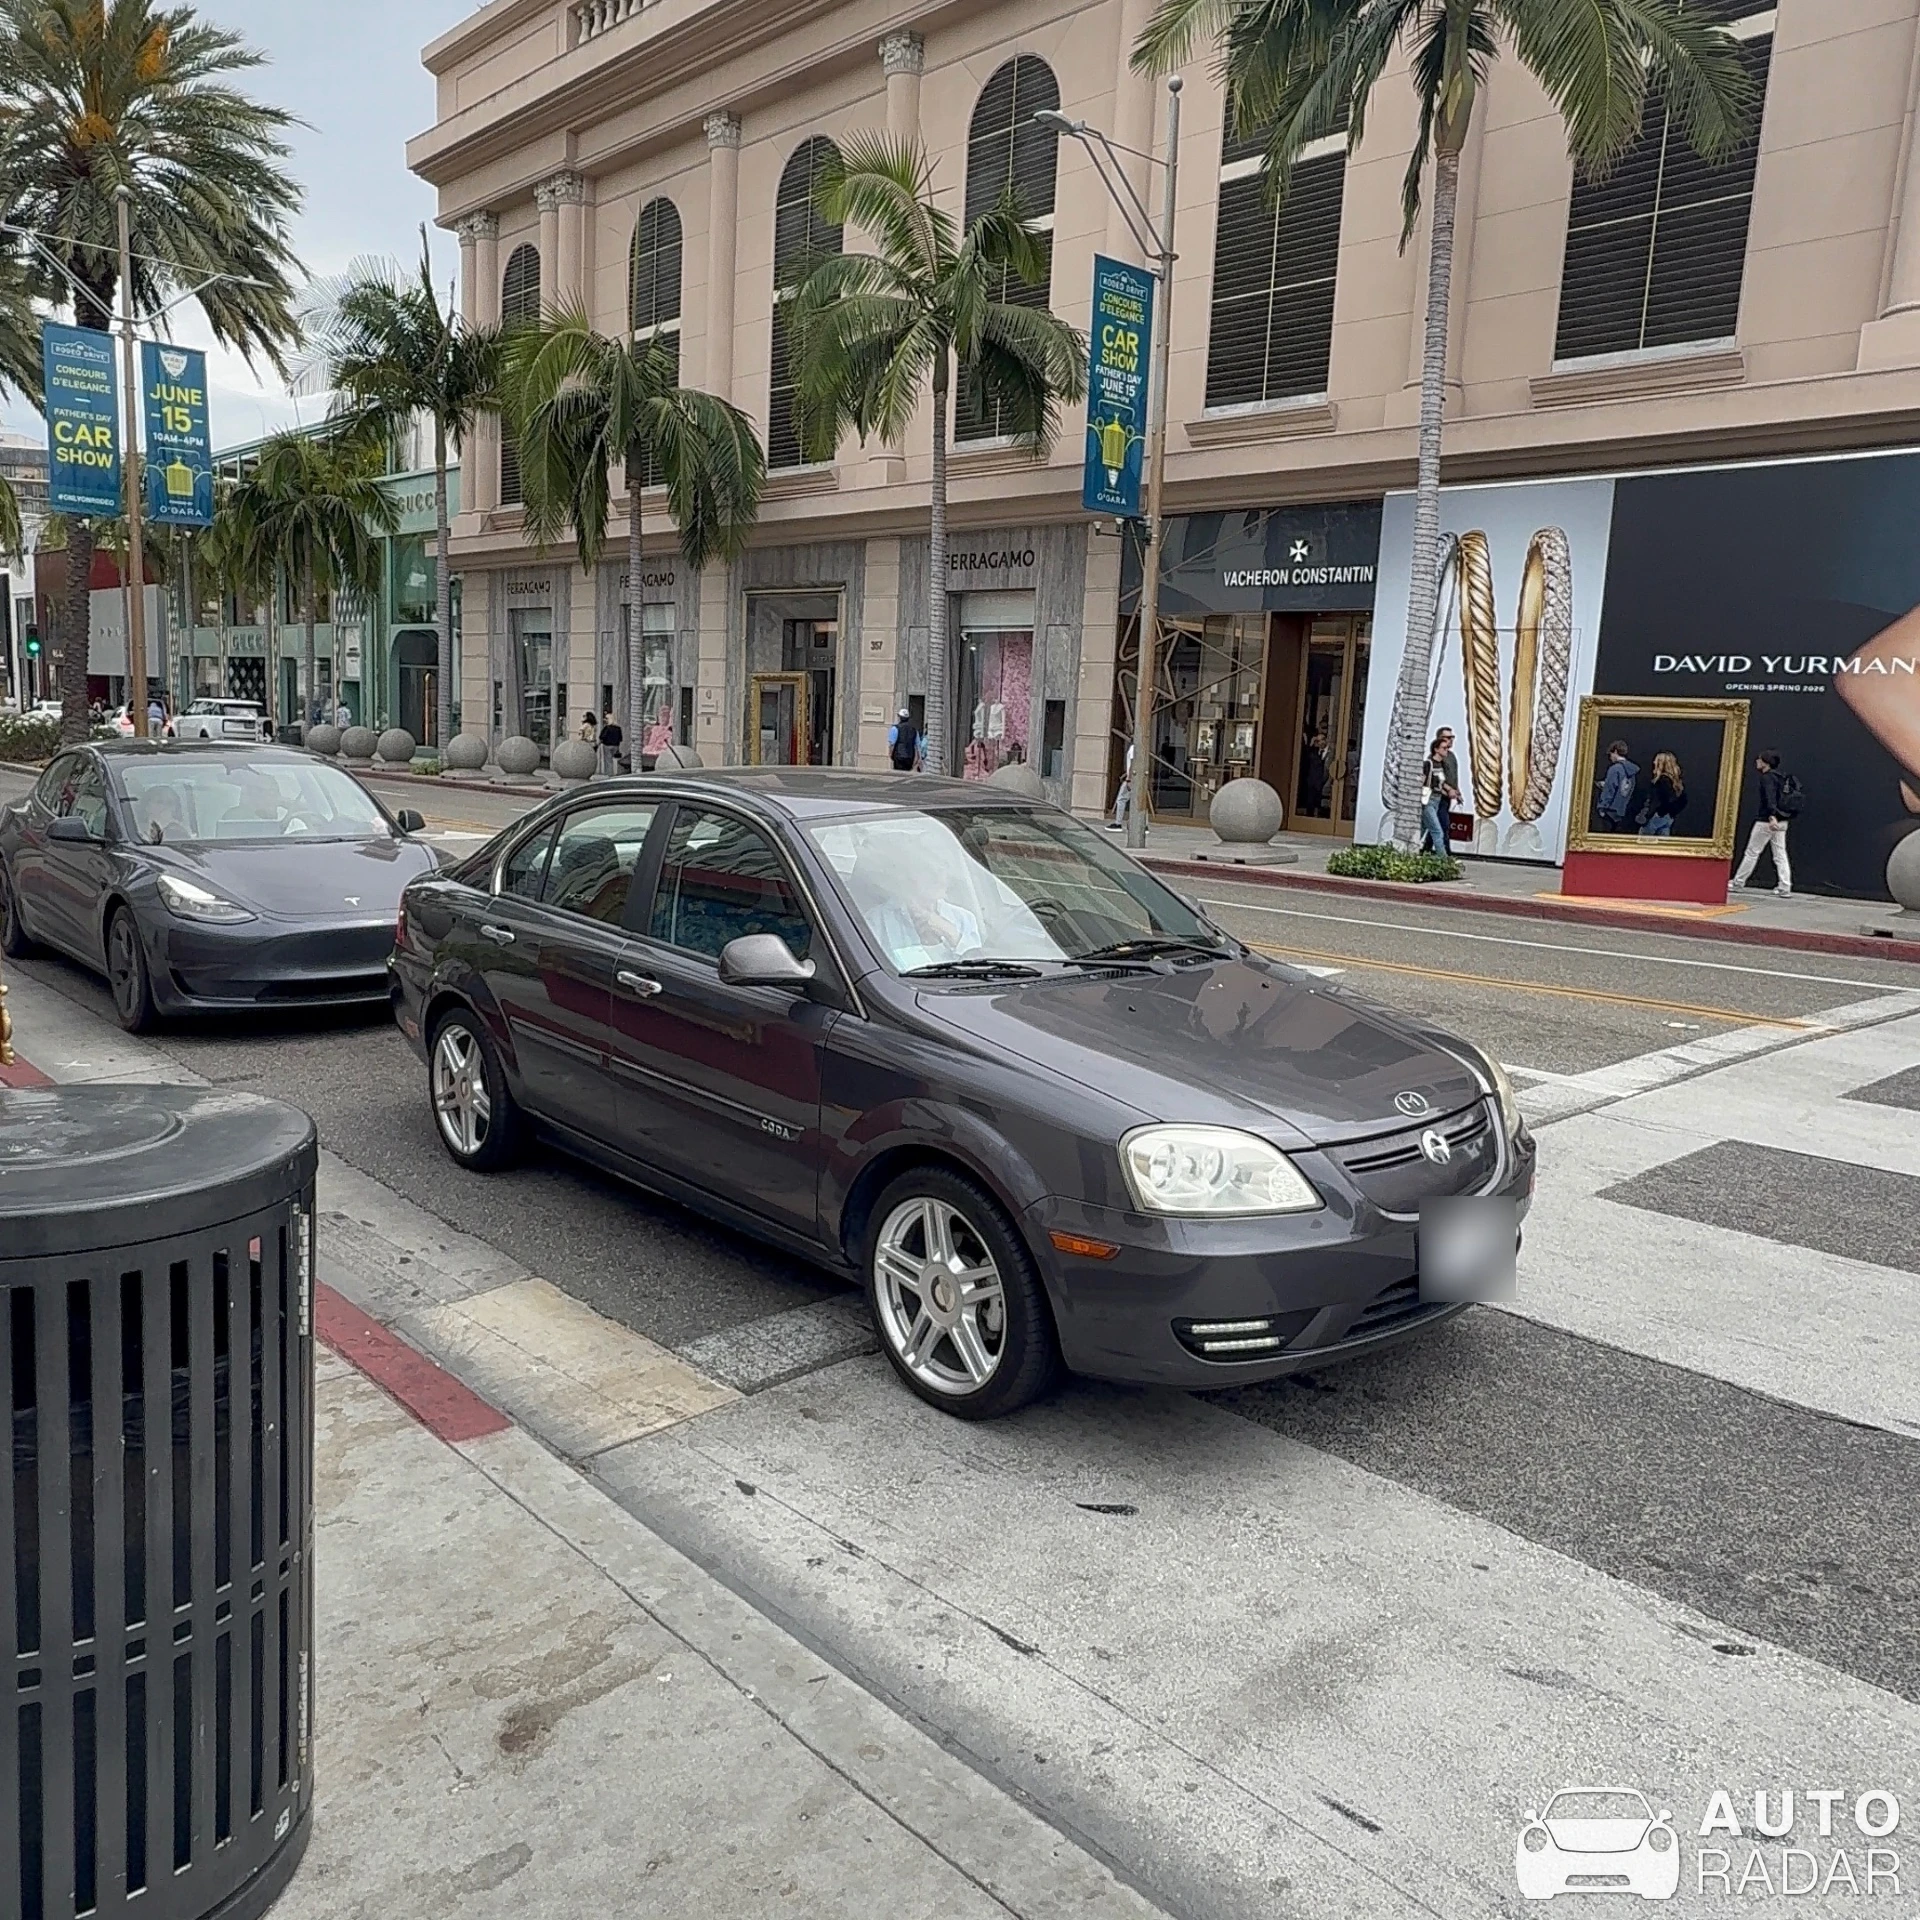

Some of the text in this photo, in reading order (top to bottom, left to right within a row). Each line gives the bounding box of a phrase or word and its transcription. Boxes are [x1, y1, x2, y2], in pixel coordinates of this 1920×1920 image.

[1102, 292, 1143, 313] CONCOURS
[1102, 324, 1139, 356] CAR
[55, 345, 107, 361] RODEO DRIVE
[1101, 348, 1139, 372] SHOW
[55, 364, 108, 380] CONCOURS
[1127, 374, 1143, 385] DAY
[52, 376, 112, 394] D'ELEGANCE
[149, 383, 203, 406] JUNE
[1100, 377, 1136, 397] JUNE 15
[54, 407, 112, 423] FATHER'S DAY
[161, 405, 192, 433] 15
[54, 420, 113, 449] CAR
[56, 447, 114, 469] SHOW
[619, 572, 675, 588] FEAGAMO
[1223, 565, 1374, 587] VACHERON CONSTANTIN
[870, 640, 883, 651] 357
[1653, 655, 1916, 675] DAVID YURMAN
[1725, 683, 1765, 691] OPENING
[1766, 684, 1801, 692] SPRING
[761, 1119, 790, 1140] CODA
